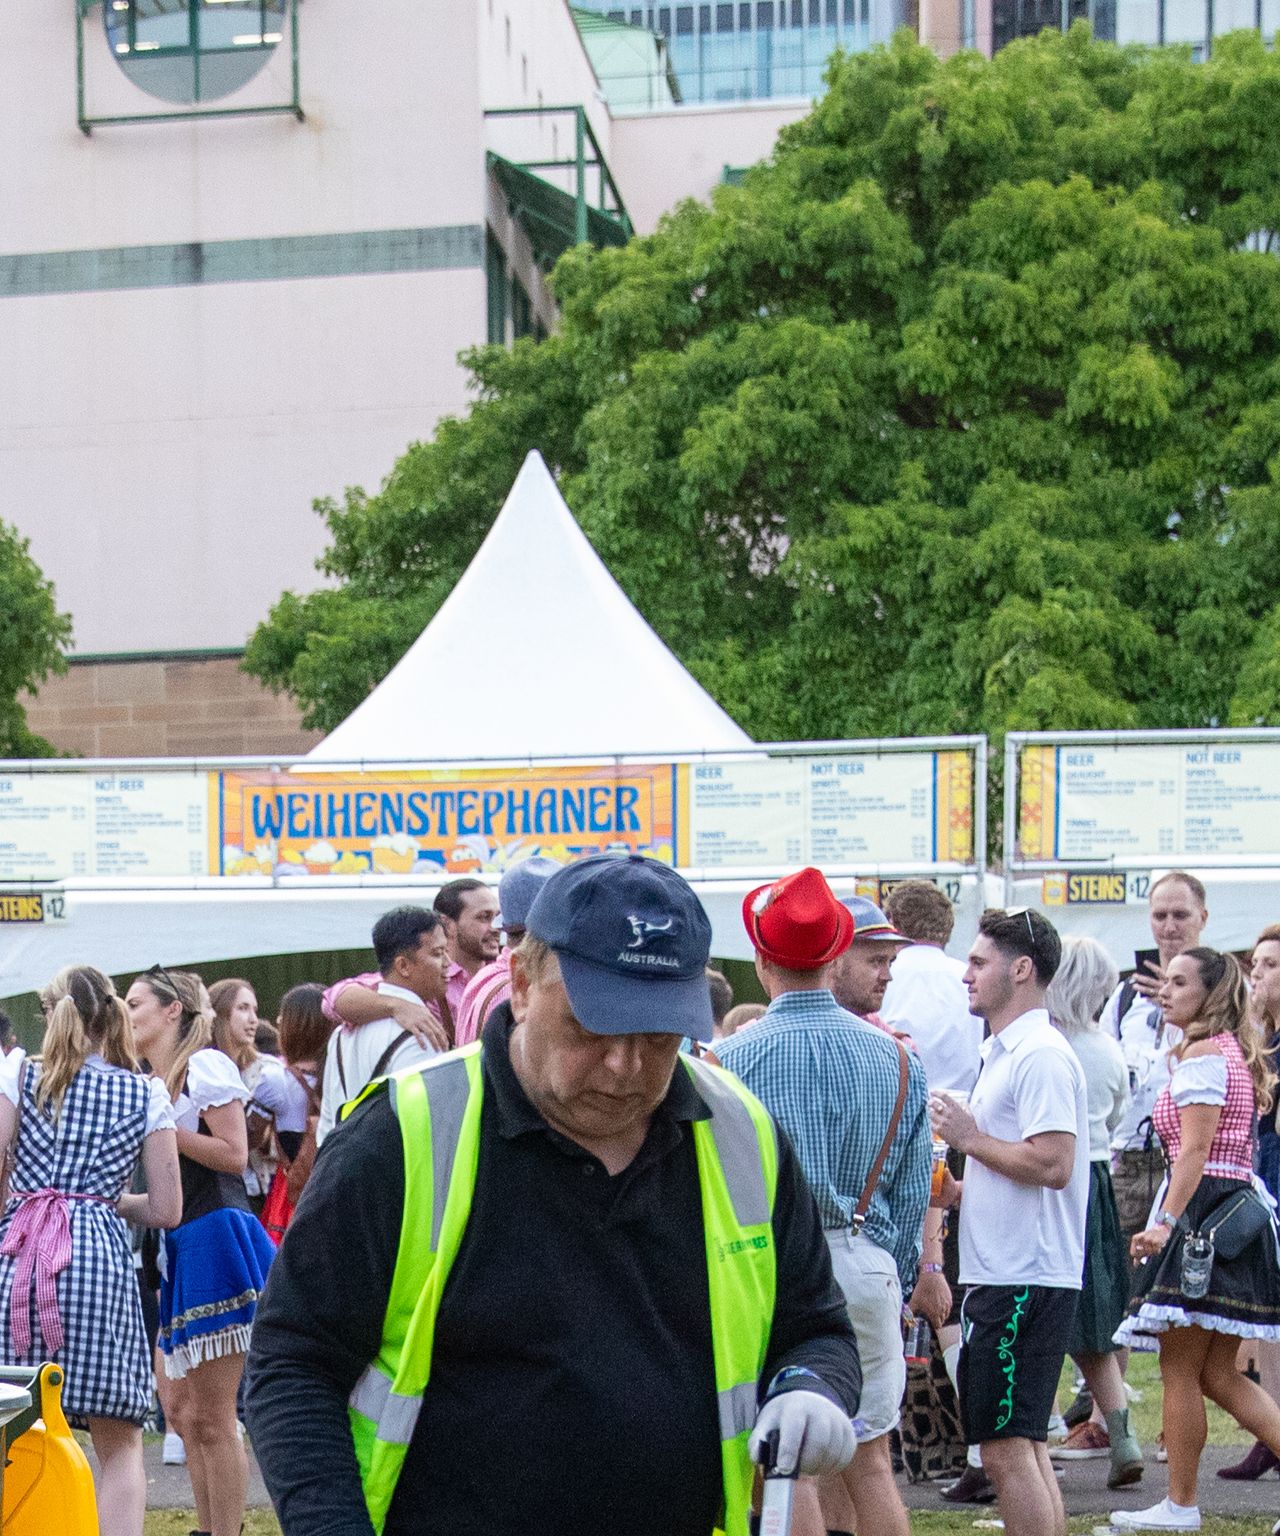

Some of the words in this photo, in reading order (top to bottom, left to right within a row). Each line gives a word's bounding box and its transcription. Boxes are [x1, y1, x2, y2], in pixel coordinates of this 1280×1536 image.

[1066, 754, 1095, 766] BEER
[1186, 752, 1208, 763] NOT
[1213, 751, 1242, 763] BEER
[696, 767, 722, 778] BEER
[811, 764, 833, 775] NOT
[837, 763, 865, 774] BEER
[251, 786, 640, 838] WEIHENSTEPHANER
[1069, 875, 1125, 901] STEINS
[618, 952, 680, 967] AUSTRALIA
